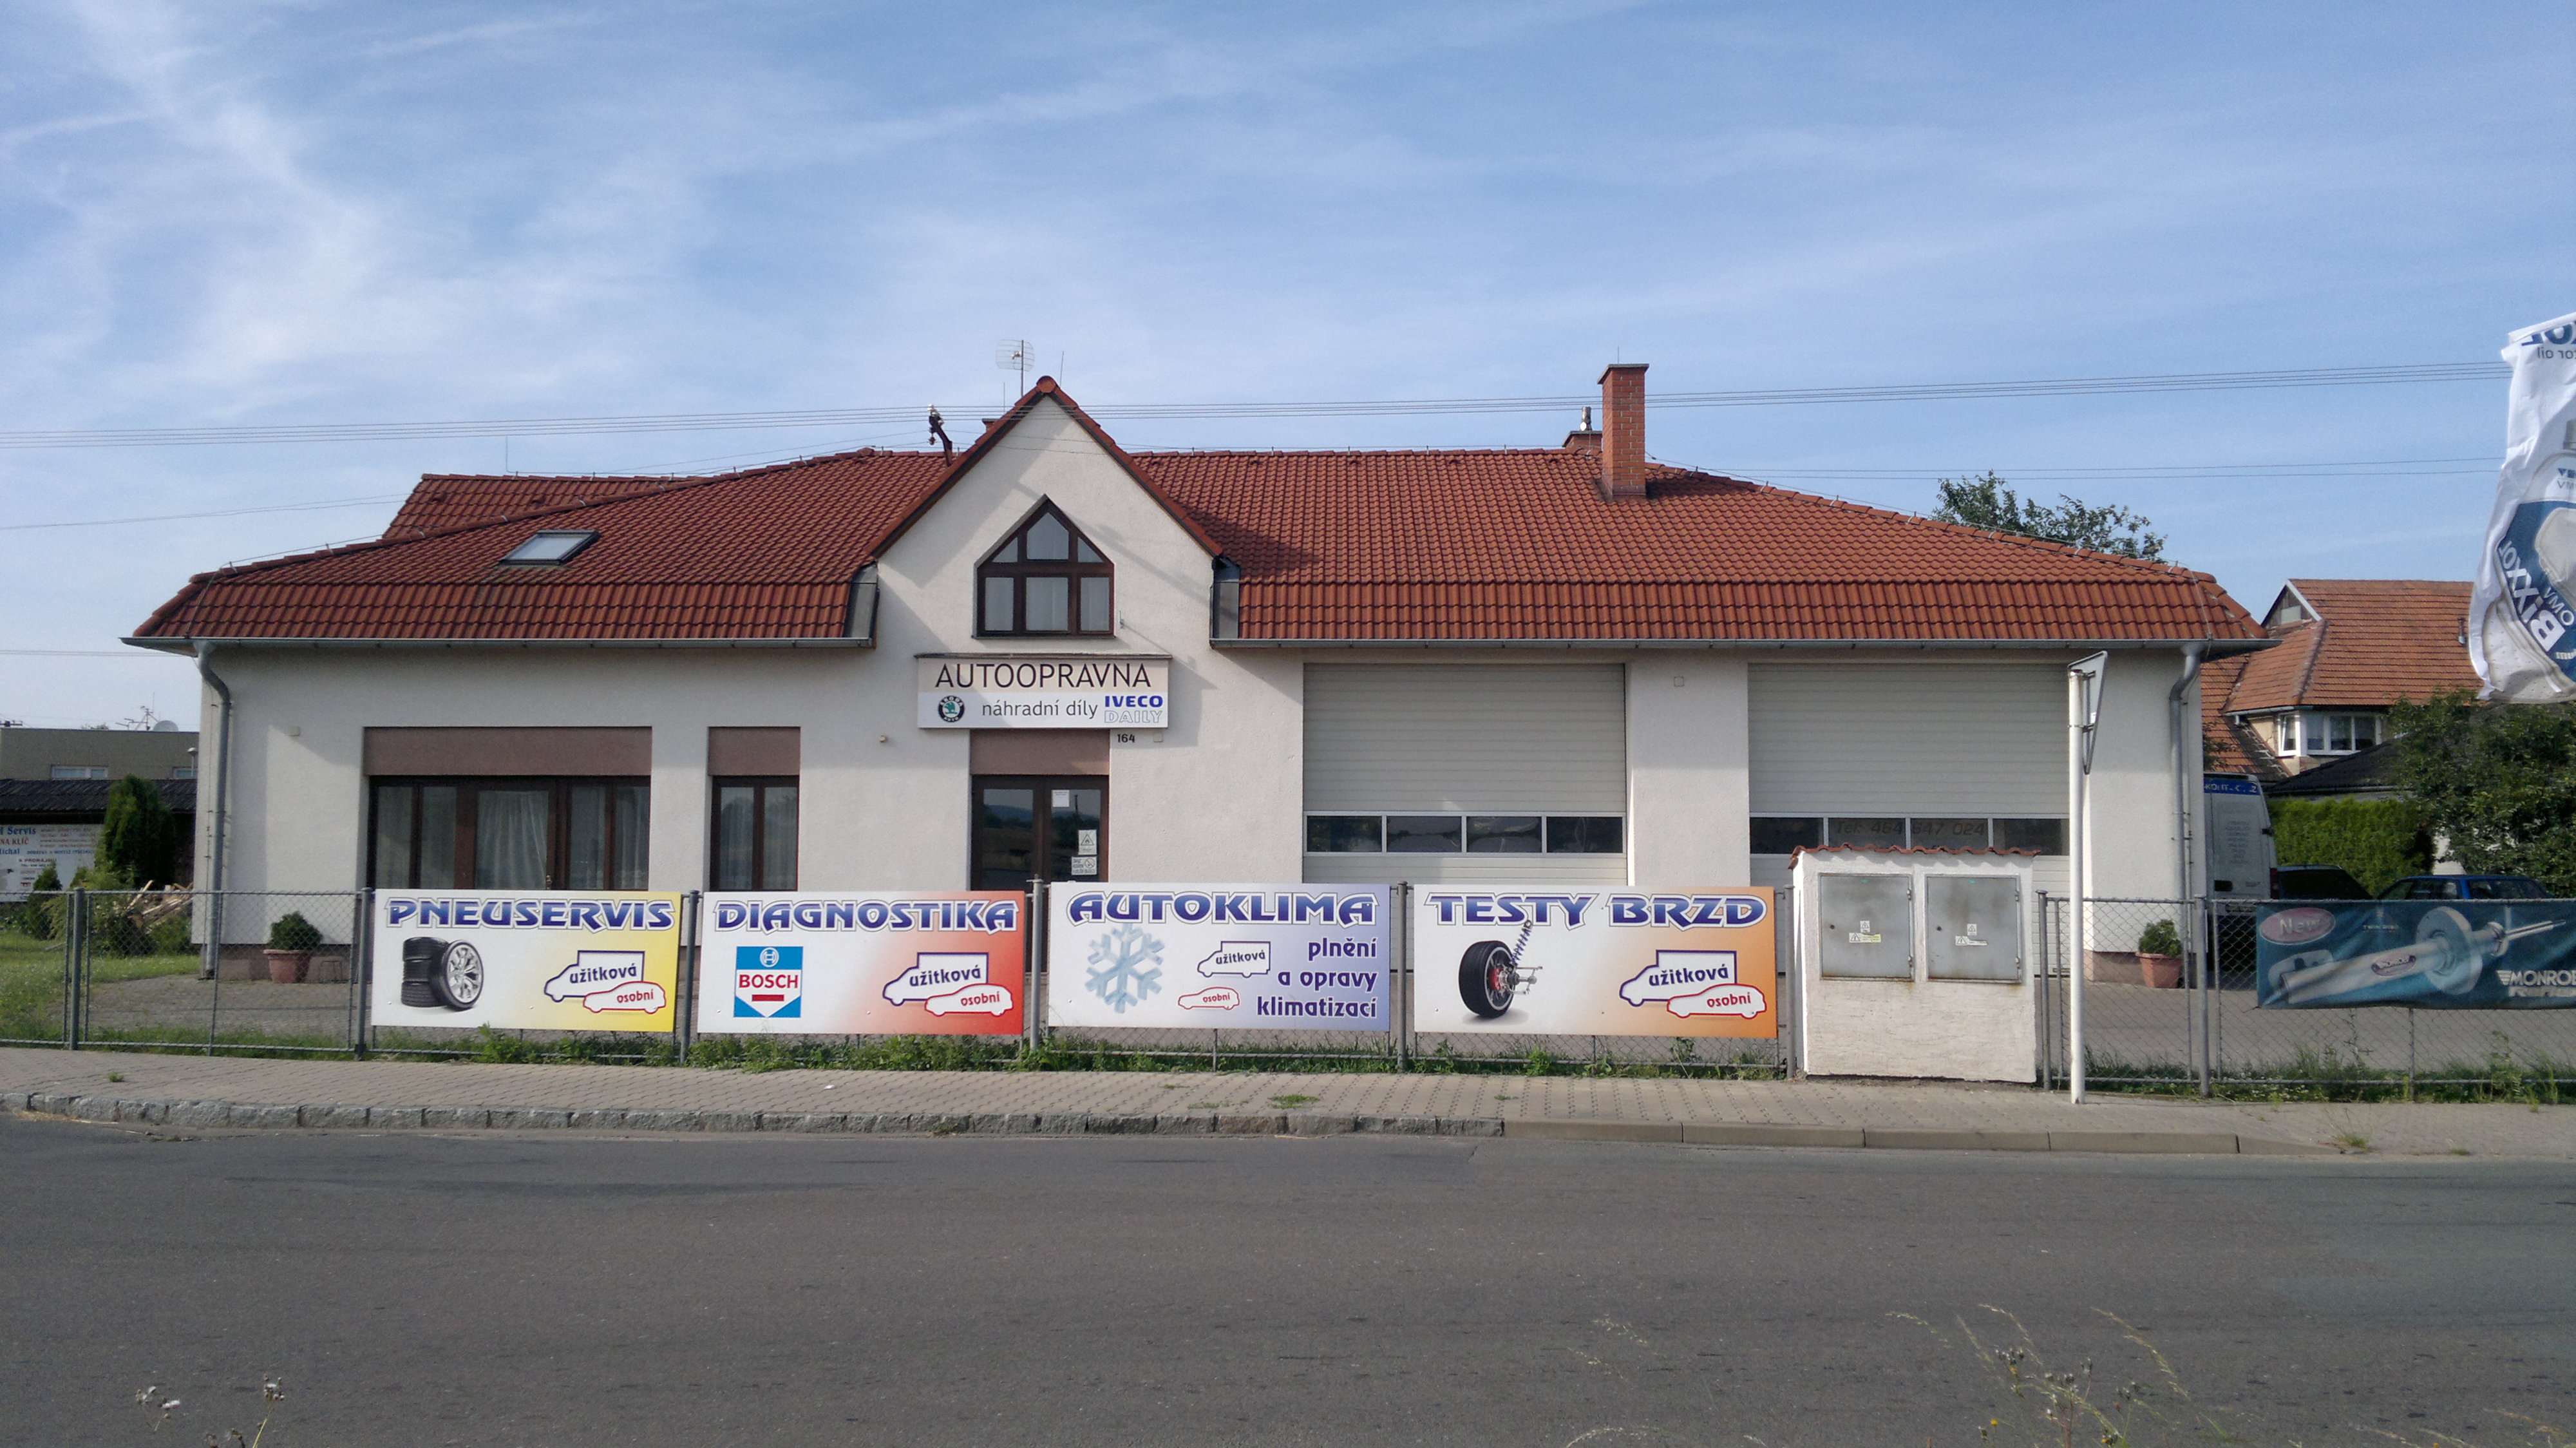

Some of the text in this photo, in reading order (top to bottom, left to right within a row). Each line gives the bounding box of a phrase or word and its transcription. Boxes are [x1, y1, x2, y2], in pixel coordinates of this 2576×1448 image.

[935, 663, 1151, 688] AUTOOPRAVNA
[982, 700, 1098, 719] náhradní díly
[1104, 696, 1163, 707] IVECO
[1104, 710, 1162, 723] DAILY
[1117, 733, 1135, 743] 164
[8, 826, 36, 835] Servis
[386, 898, 676, 933] PNEUSERVIS
[714, 900, 1019, 934] DIAGNOSTIKA
[1067, 891, 1379, 929] AUTOKLIMA
[1425, 892, 1767, 931] TESTY BRZD
[1215, 949, 1266, 965] užitková
[1308, 937, 1377, 961] plnění
[569, 962, 637, 984] užitková
[739, 974, 799, 989] BOSCH
[909, 964, 981, 987] užitková
[1278, 971, 1378, 992] a opravy
[1649, 964, 1729, 987] užitková
[616, 988, 654, 1004] osobní
[960, 991, 1001, 1006] osobní
[1202, 992, 1231, 1003] osobní
[1707, 992, 1752, 1008] osobní
[1257, 996, 1377, 1018] klimatizací
